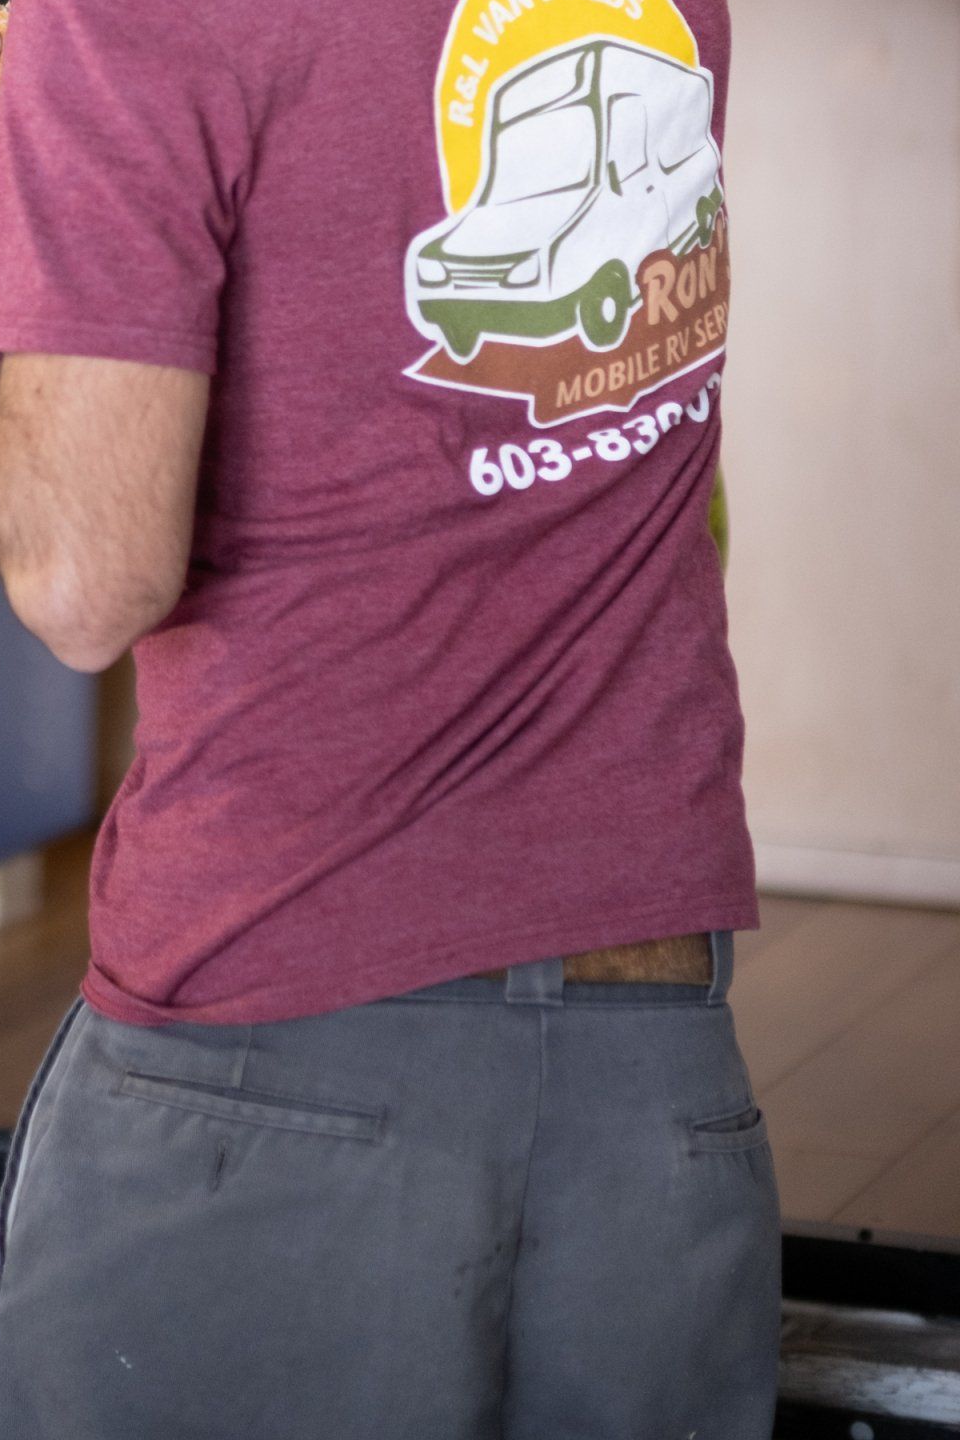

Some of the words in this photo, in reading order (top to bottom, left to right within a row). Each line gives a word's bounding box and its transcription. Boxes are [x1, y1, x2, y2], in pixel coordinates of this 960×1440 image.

[448, 54, 489, 128] R&L
[555, 343, 660, 408] MOBILE
[666, 326, 690, 366] RV
